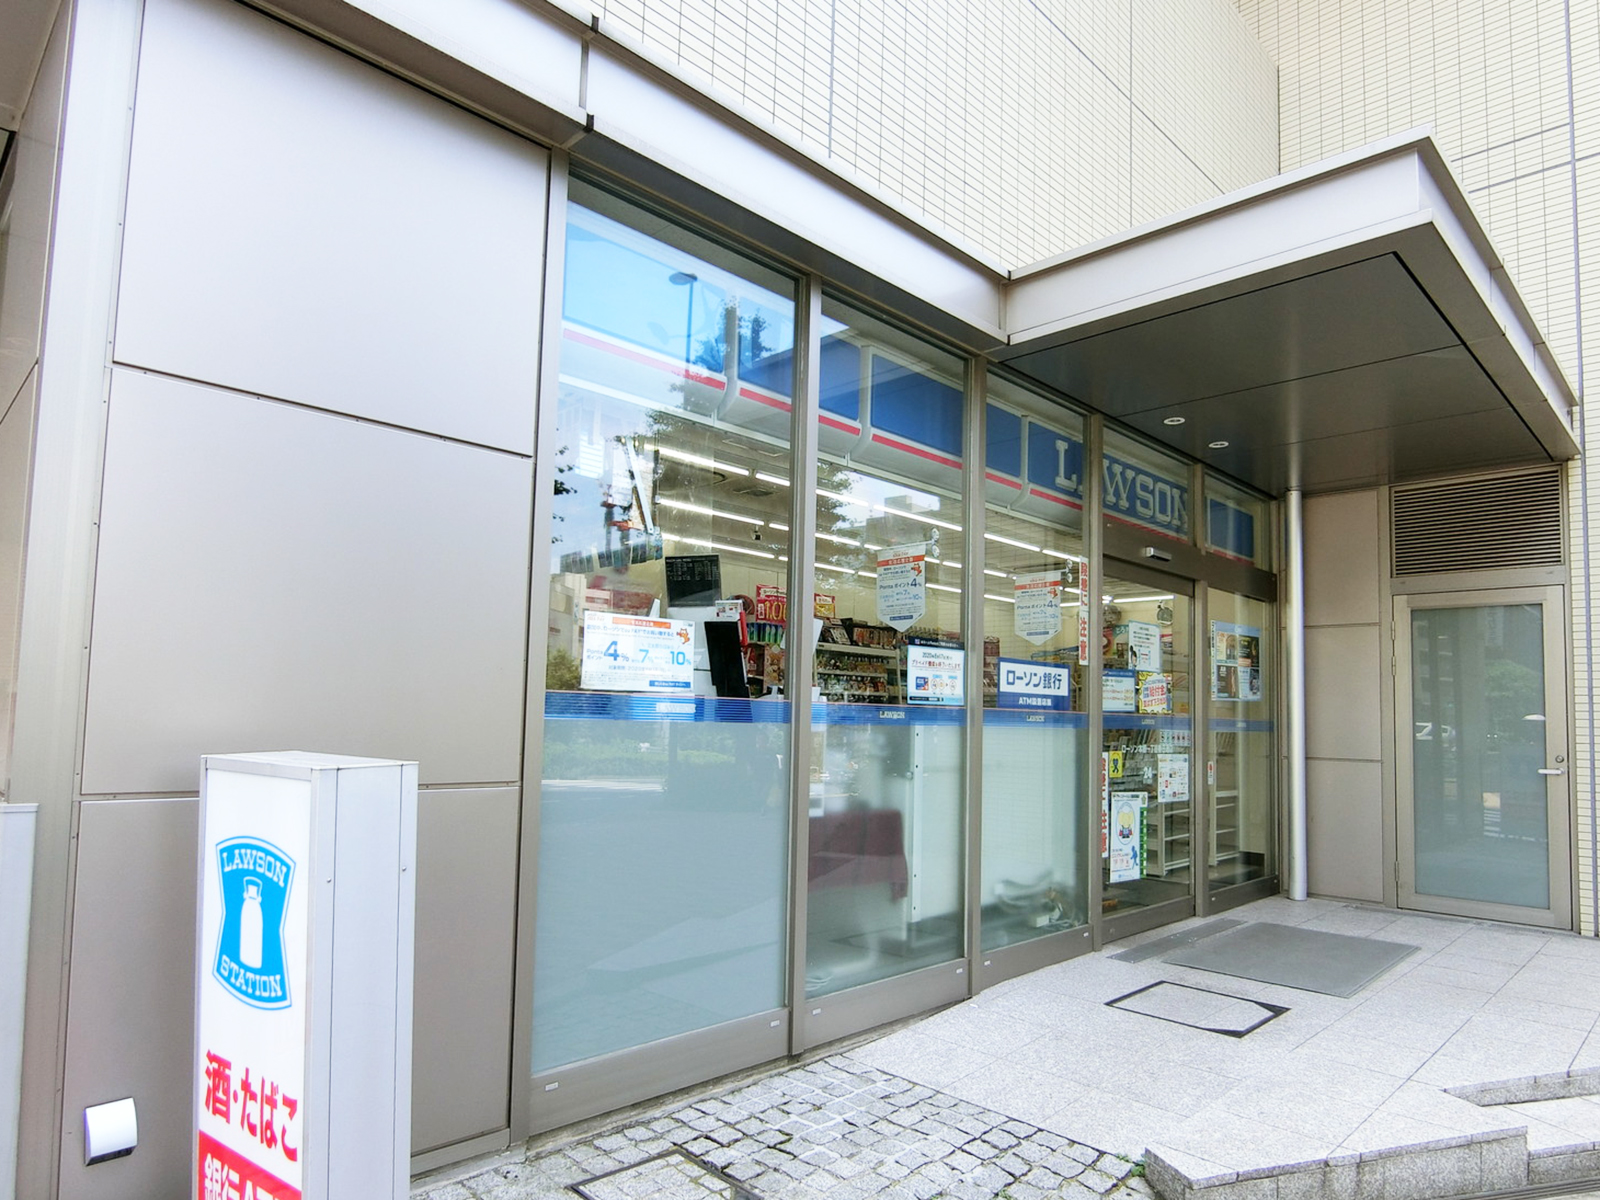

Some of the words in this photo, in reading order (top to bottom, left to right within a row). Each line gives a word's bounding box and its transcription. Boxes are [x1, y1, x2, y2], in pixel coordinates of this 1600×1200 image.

[1006, 669, 1063, 690] ローソン銀行
[222, 850, 288, 889] LAWSON
[220, 954, 284, 998] STATION
[204, 1049, 298, 1162] 酒・たばこ
